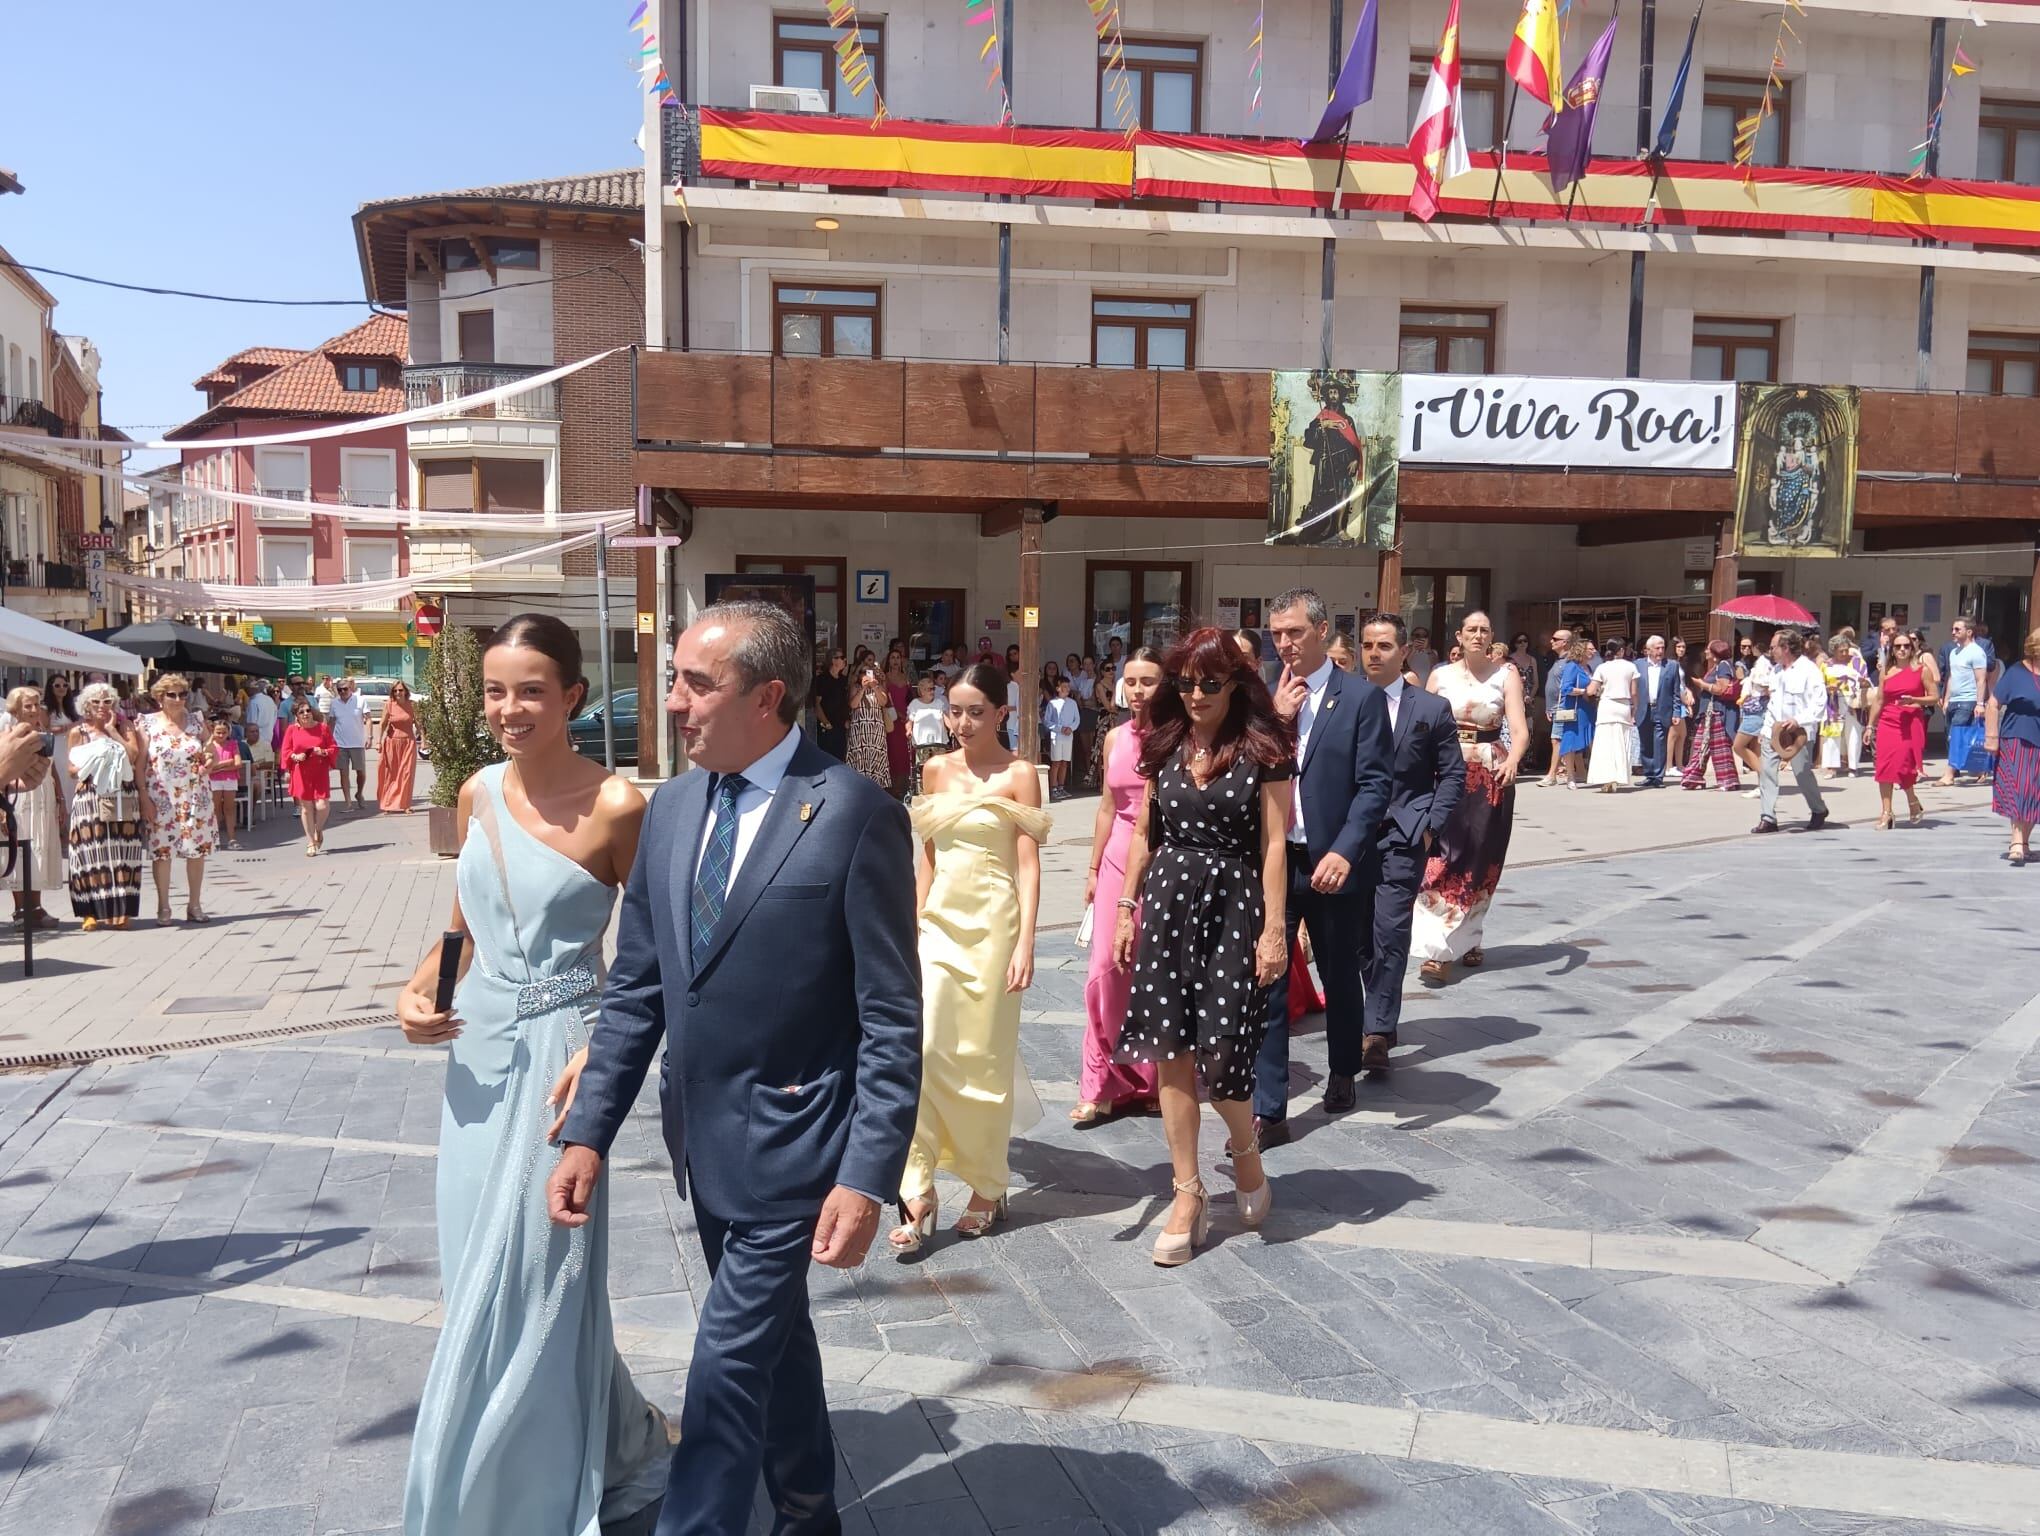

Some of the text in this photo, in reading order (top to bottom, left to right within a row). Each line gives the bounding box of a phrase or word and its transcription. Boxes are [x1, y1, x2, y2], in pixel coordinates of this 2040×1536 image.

[1412, 387, 1723, 452] ¡Viva Roa!
[81, 535, 113, 548] BAR
